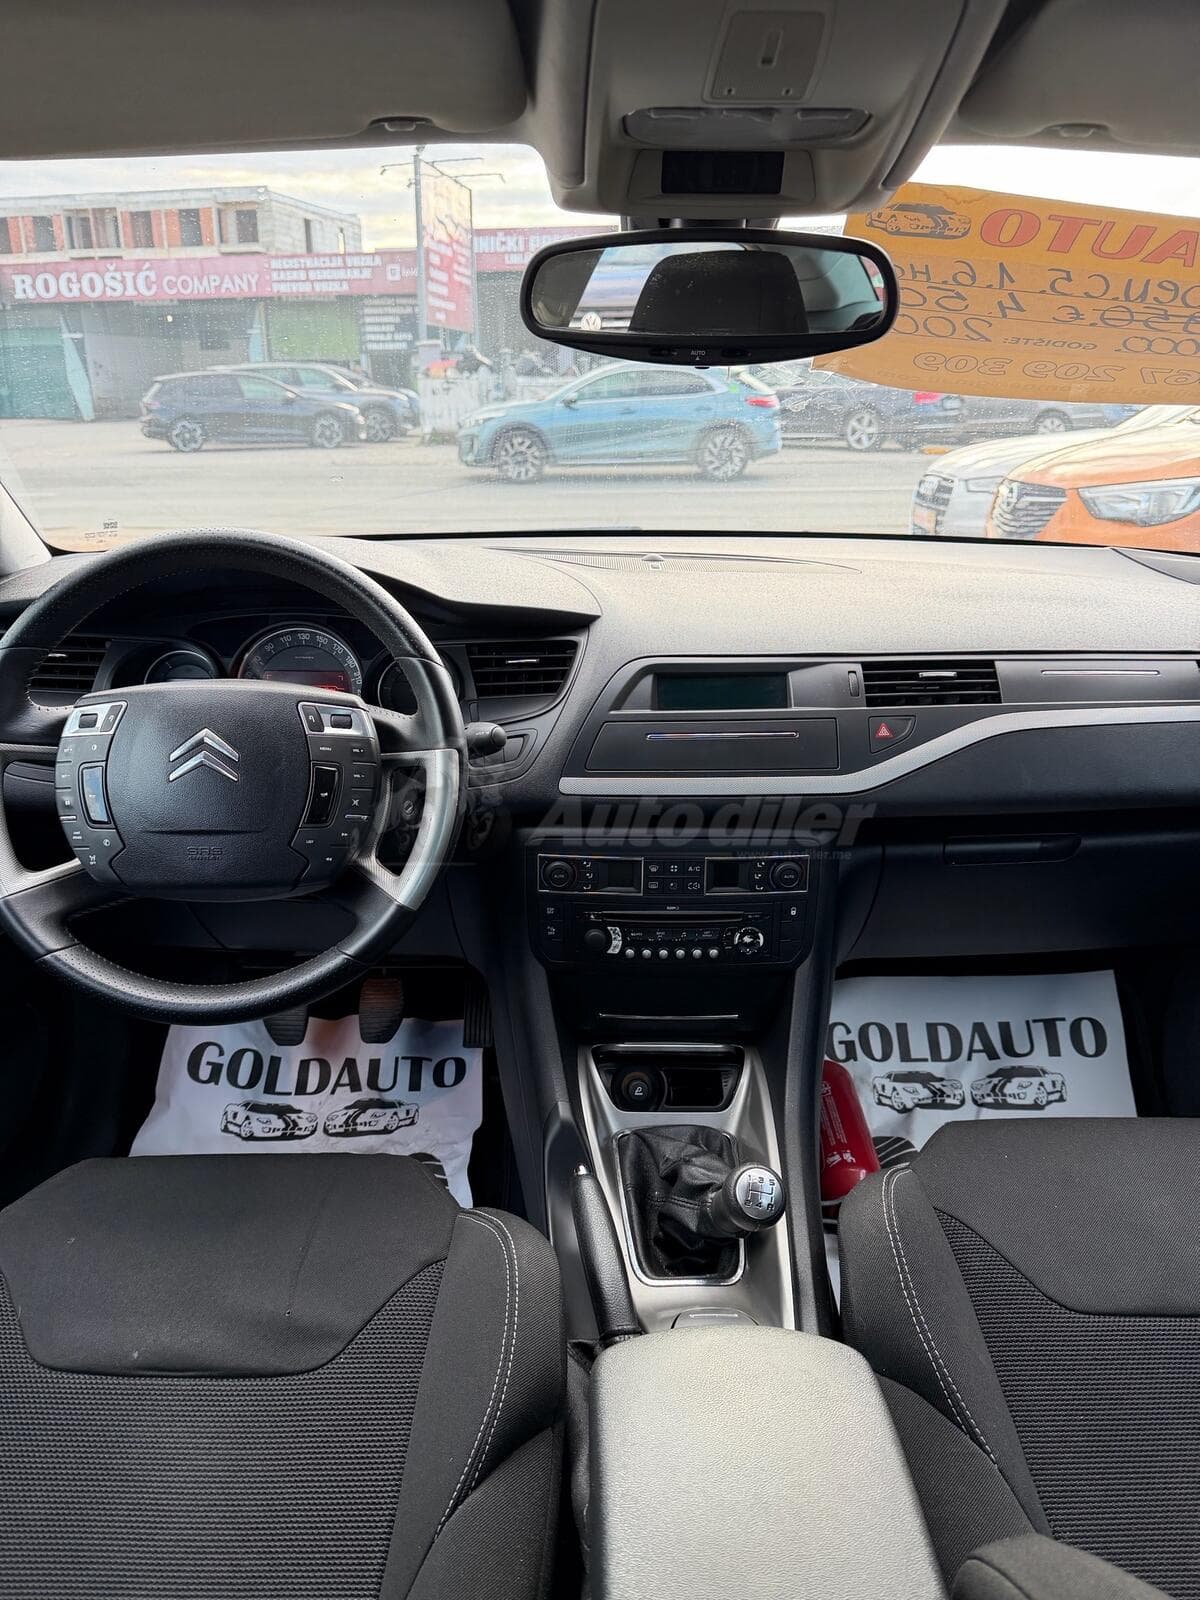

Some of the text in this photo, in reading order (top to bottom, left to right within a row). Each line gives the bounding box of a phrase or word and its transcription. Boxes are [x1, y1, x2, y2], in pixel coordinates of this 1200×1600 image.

[11, 262, 158, 299] ROGOŠIĆ
[162, 274, 260, 295] COMPANY
[298, 633, 310, 641] 130
[687, 865, 701, 873] A/C
[826, 1016, 1108, 1064] GOLDAUTO
[186, 1041, 467, 1096] GOLDAUTO
